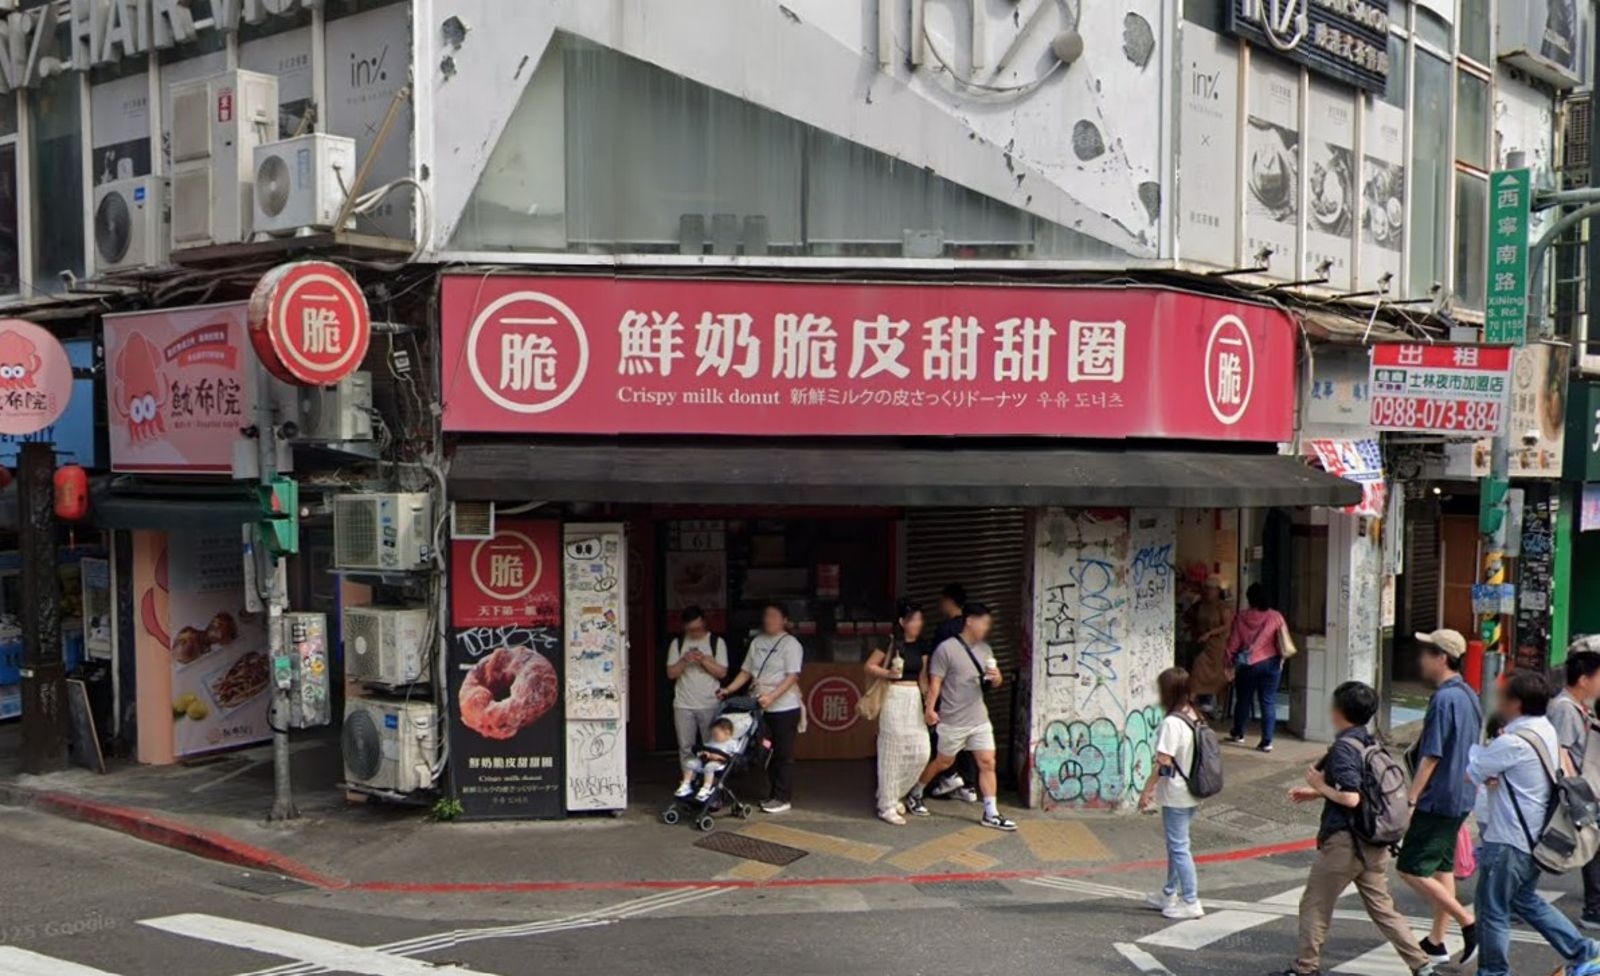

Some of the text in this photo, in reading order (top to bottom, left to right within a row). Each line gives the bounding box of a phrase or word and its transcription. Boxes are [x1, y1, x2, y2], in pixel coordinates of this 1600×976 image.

[1495, 188, 1520, 292] 西寧南路
[301, 294, 341, 355] 一脆
[617, 309, 1127, 383] 鮮奶脆皮甜甜圈
[499, 316, 558, 392] 一脆
[1216, 336, 1243, 406] 一脆
[0, 391, 48, 411] 布院
[617, 386, 1124, 409] Crispy milk donut 新鮮ミルクの皮さっくりドーナツ 우유 도너츠
[1409, 374, 1504, 393] 士林夜市加盟店
[1372, 397, 1500, 433] 0988-073-884
[489, 545, 524, 588] 一脆
[821, 688, 851, 722] 一脆
